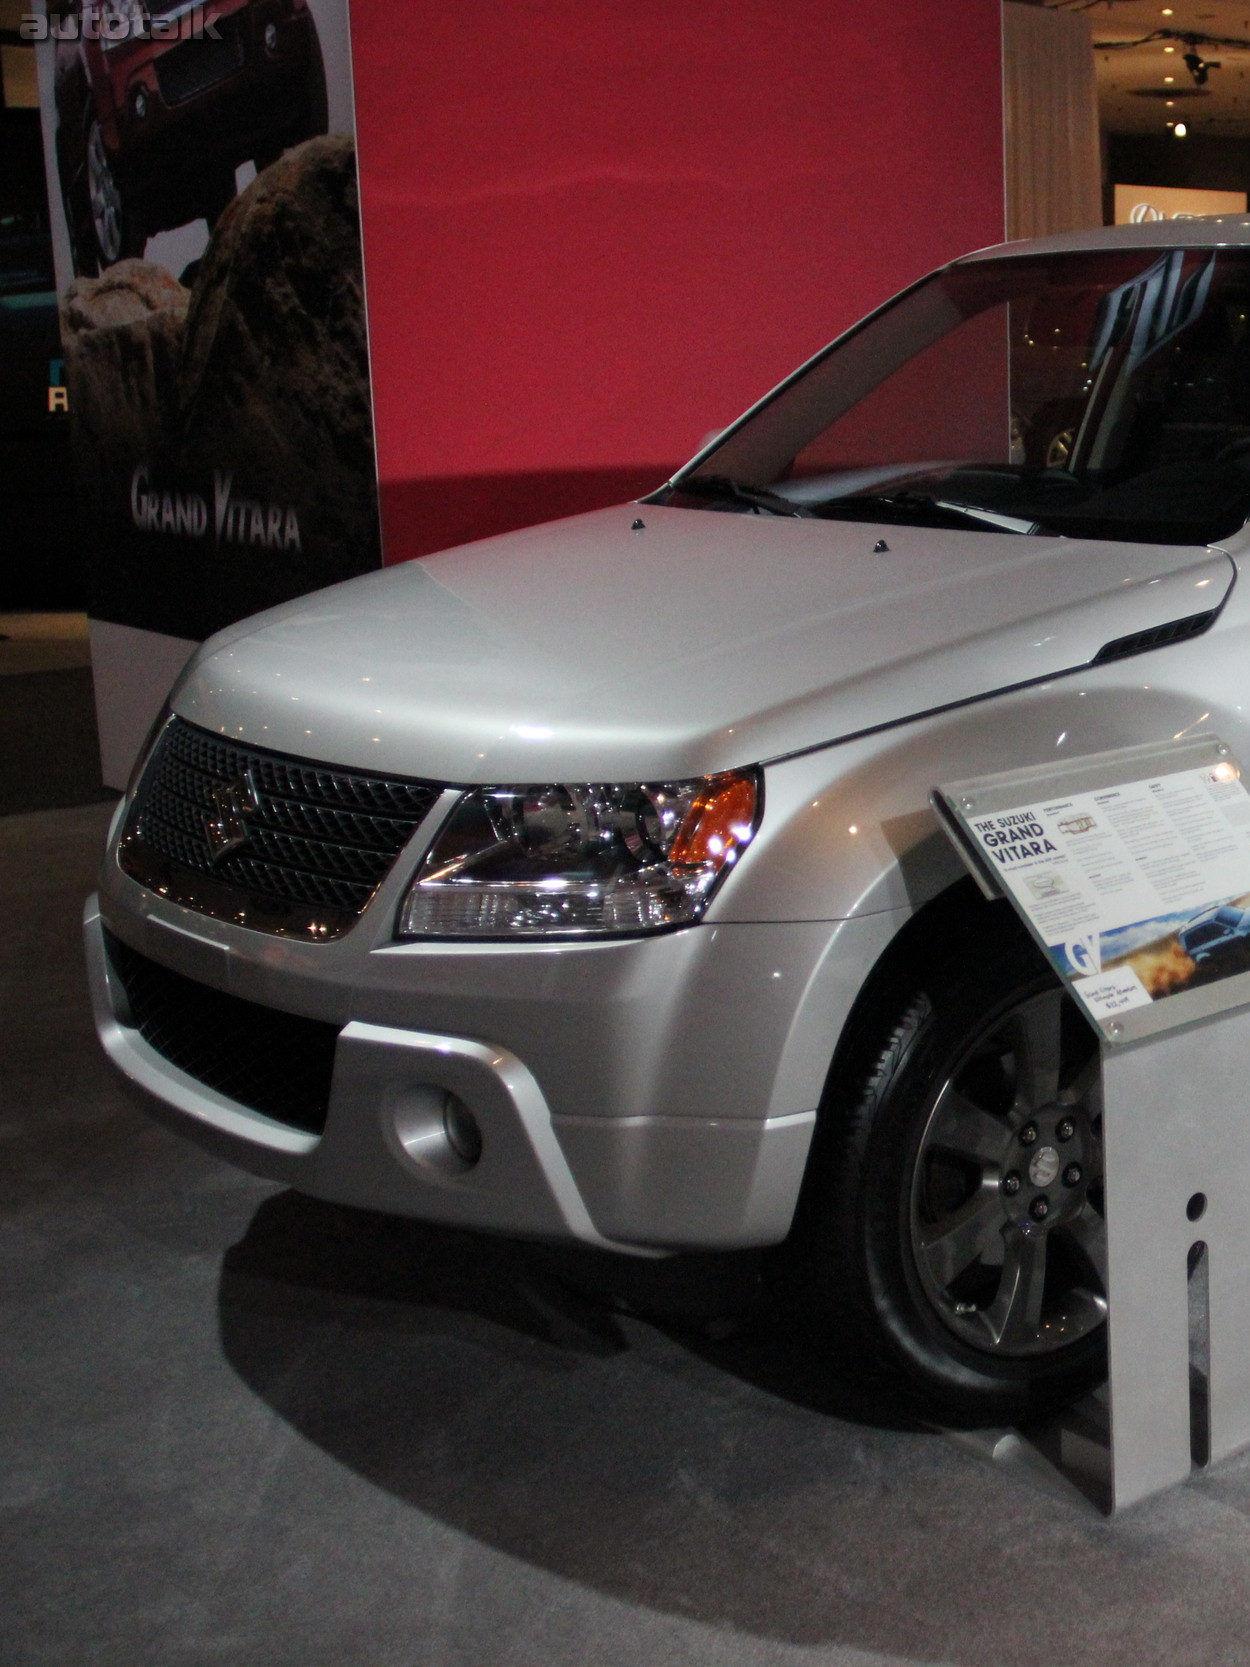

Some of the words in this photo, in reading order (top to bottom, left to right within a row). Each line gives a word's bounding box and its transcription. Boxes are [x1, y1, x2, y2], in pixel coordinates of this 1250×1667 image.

[131, 466, 207, 538] GRAND
[213, 469, 301, 552] VITARA
[974, 820, 996, 833] THE
[997, 811, 1037, 828] SUZUKI
[983, 823, 1044, 847] GRAND
[992, 838, 1058, 864] VITARA
